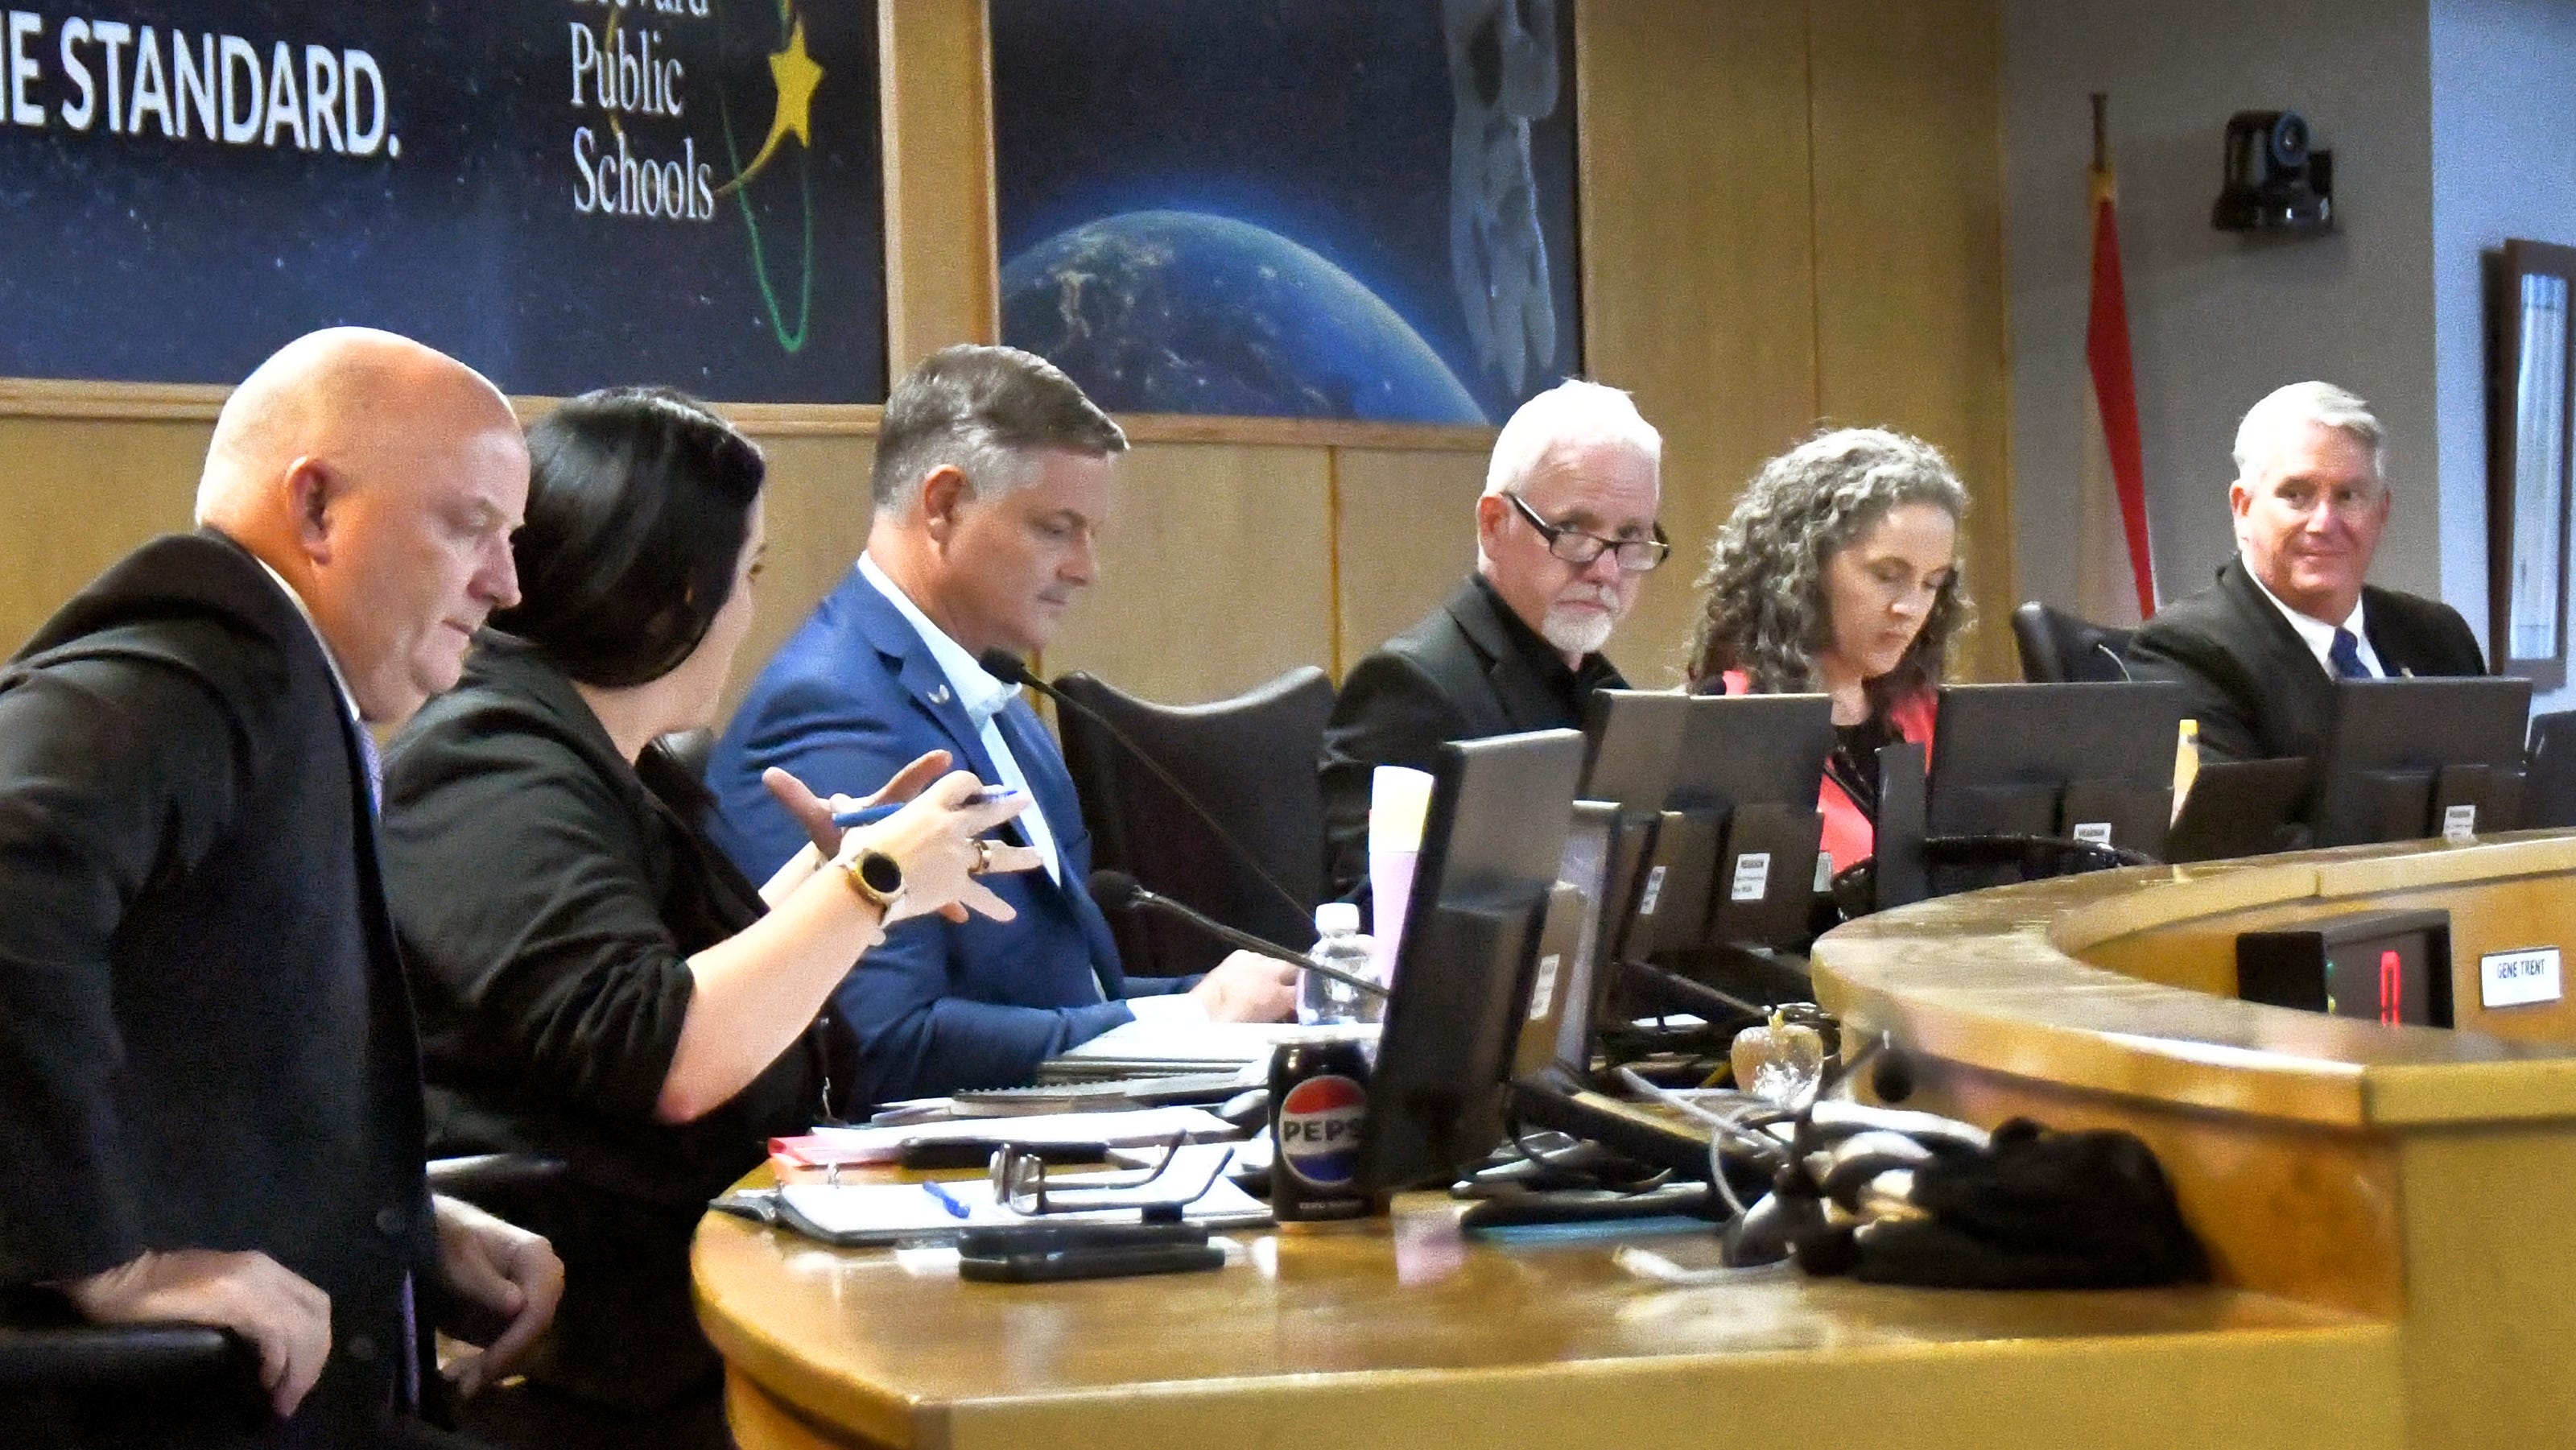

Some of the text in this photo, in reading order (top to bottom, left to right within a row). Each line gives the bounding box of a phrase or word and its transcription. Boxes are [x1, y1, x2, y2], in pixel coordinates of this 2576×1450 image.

[0, 10, 401, 159] E STANDARD.
[570, 22, 683, 117] Public
[573, 126, 713, 221] Schools
[2497, 958, 2545, 979] GENE TRENT
